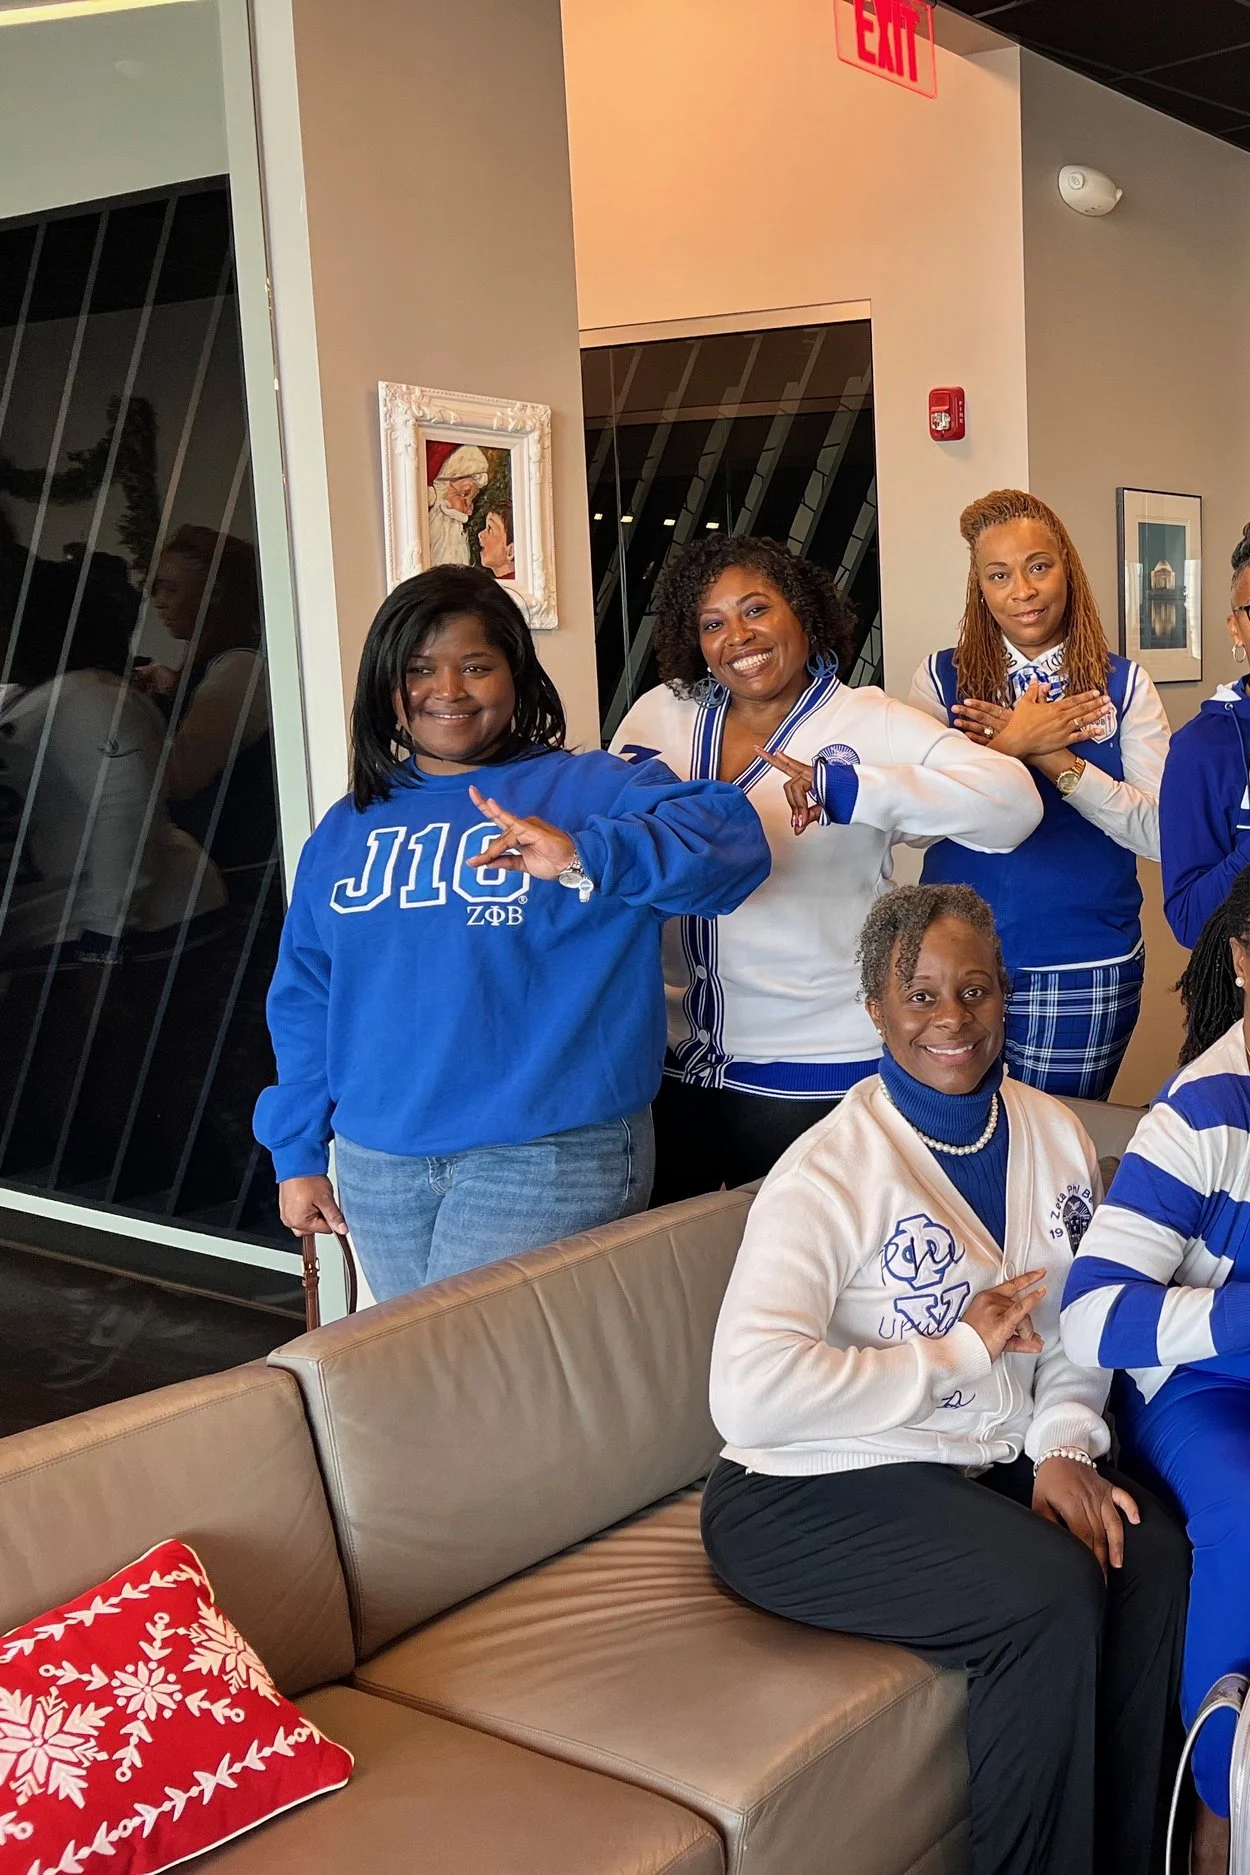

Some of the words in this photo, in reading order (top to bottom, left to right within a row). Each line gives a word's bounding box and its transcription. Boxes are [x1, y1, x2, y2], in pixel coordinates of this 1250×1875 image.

[853, 0, 920, 82] EXIT
[1051, 1192, 1067, 1220] Zeta
[1049, 1226, 1064, 1240] 19
